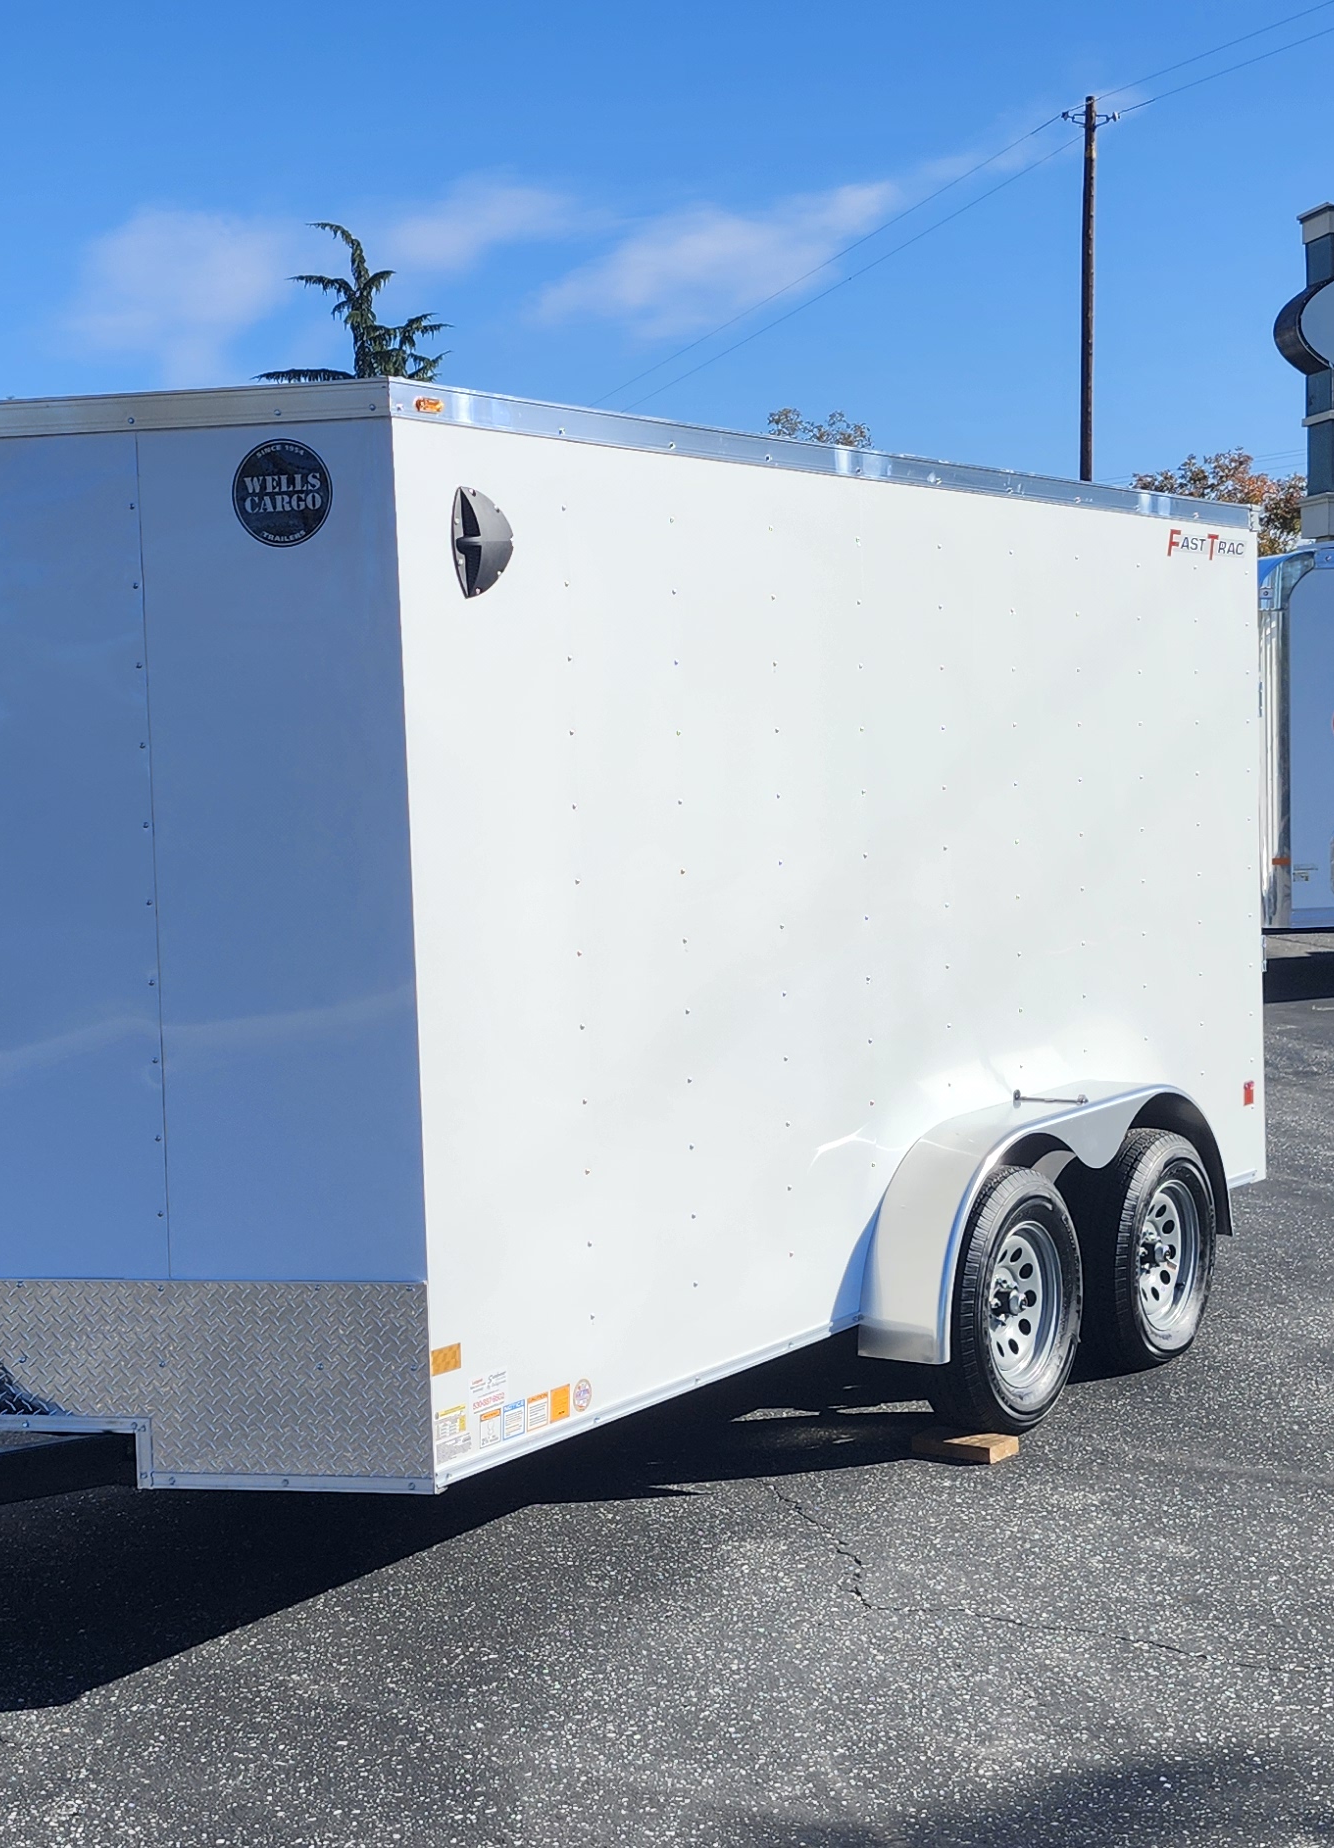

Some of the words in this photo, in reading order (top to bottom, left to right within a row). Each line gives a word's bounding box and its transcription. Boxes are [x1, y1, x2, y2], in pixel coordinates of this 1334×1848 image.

[255, 444, 282, 459] SINCE
[284, 444, 305, 456] 1954
[243, 472, 321, 494] WELLS
[244, 492, 322, 514] CARGO
[261, 529, 306, 542] TRAILERS
